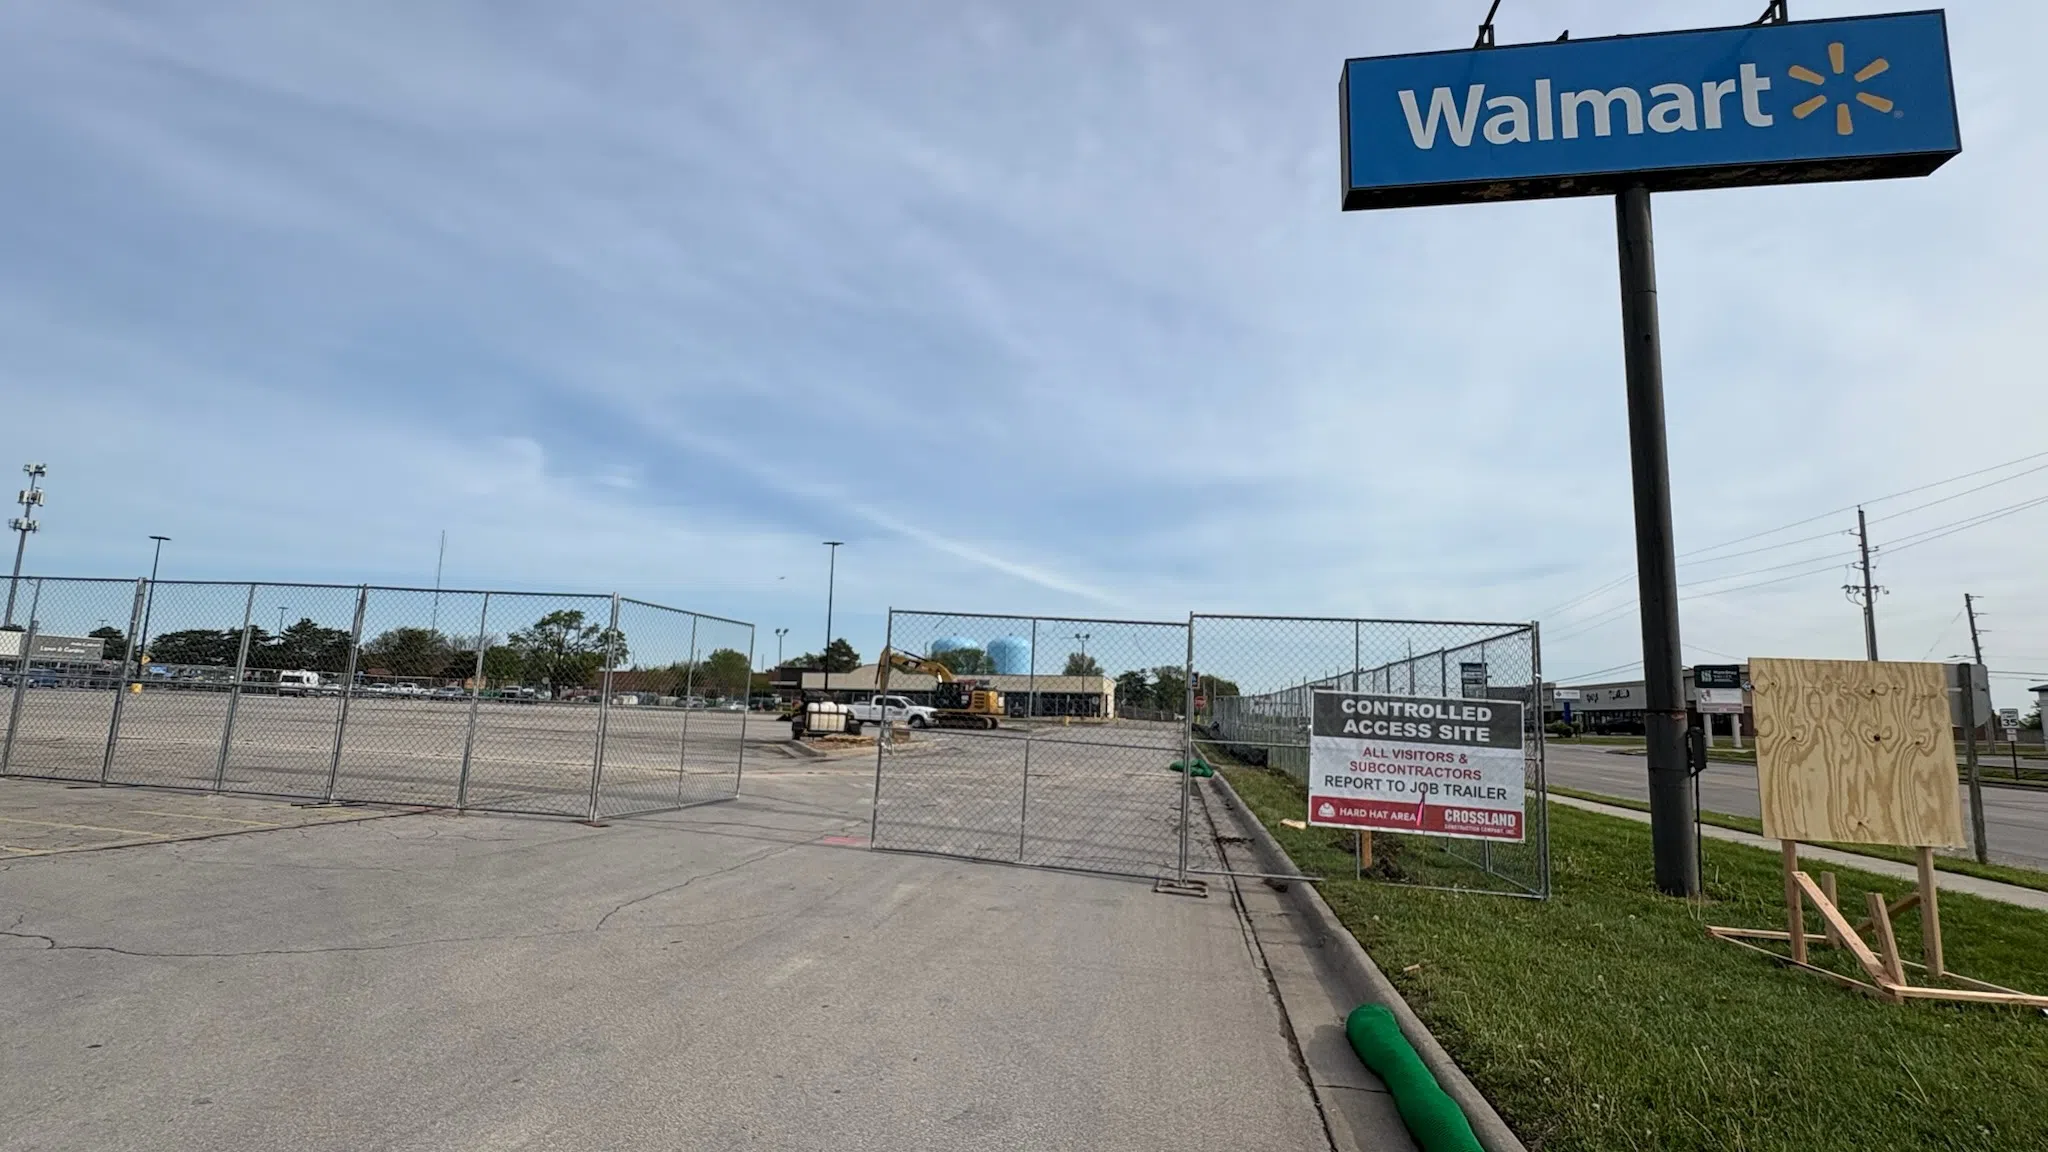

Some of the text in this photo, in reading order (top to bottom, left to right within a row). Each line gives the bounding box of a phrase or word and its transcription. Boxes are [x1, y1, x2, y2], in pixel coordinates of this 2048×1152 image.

[1398, 63, 1773, 150] Walmart
[1341, 700, 1492, 722] CONTROLLED
[1343, 719, 1490, 742] ACCESS SITE
[2003, 718, 2018, 726] 35
[1362, 747, 1468, 764] ALL VISITORS &
[1350, 761, 1482, 780] SUBCONTRACTORS
[1325, 775, 1507, 800] REPORT TO JOB TRAILER
[1339, 807, 1417, 822] HARD HAT AREA
[1444, 808, 1516, 827] CROSSLAND
